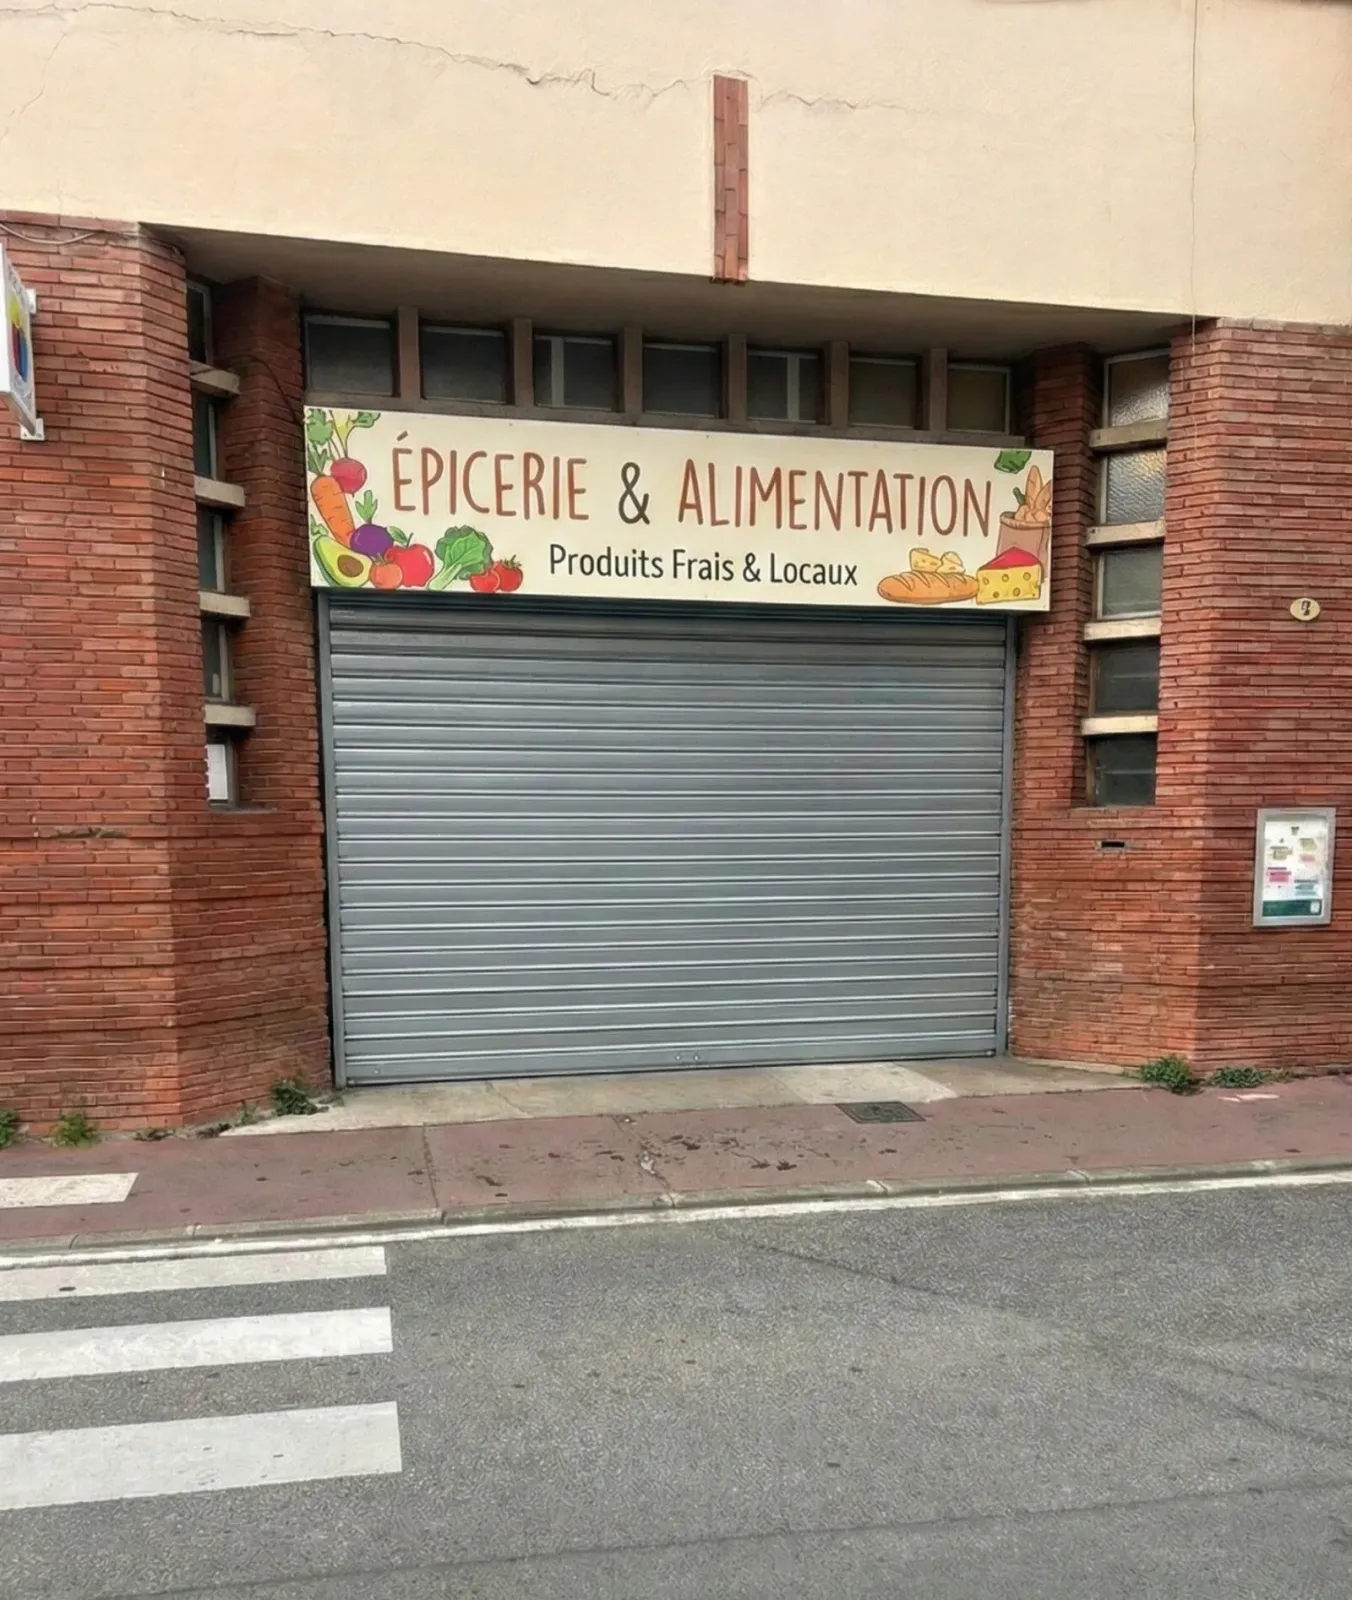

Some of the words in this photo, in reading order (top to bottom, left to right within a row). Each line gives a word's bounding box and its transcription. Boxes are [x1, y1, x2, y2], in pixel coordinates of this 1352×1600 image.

[393, 430, 590, 521] ÉPICERIE
[618, 461, 651, 525] &
[678, 459, 992, 538] ALIMENTATION
[549, 543, 664, 579] Produits
[672, 549, 735, 582] Frais
[742, 551, 762, 583] &
[769, 553, 858, 587] Locaux
